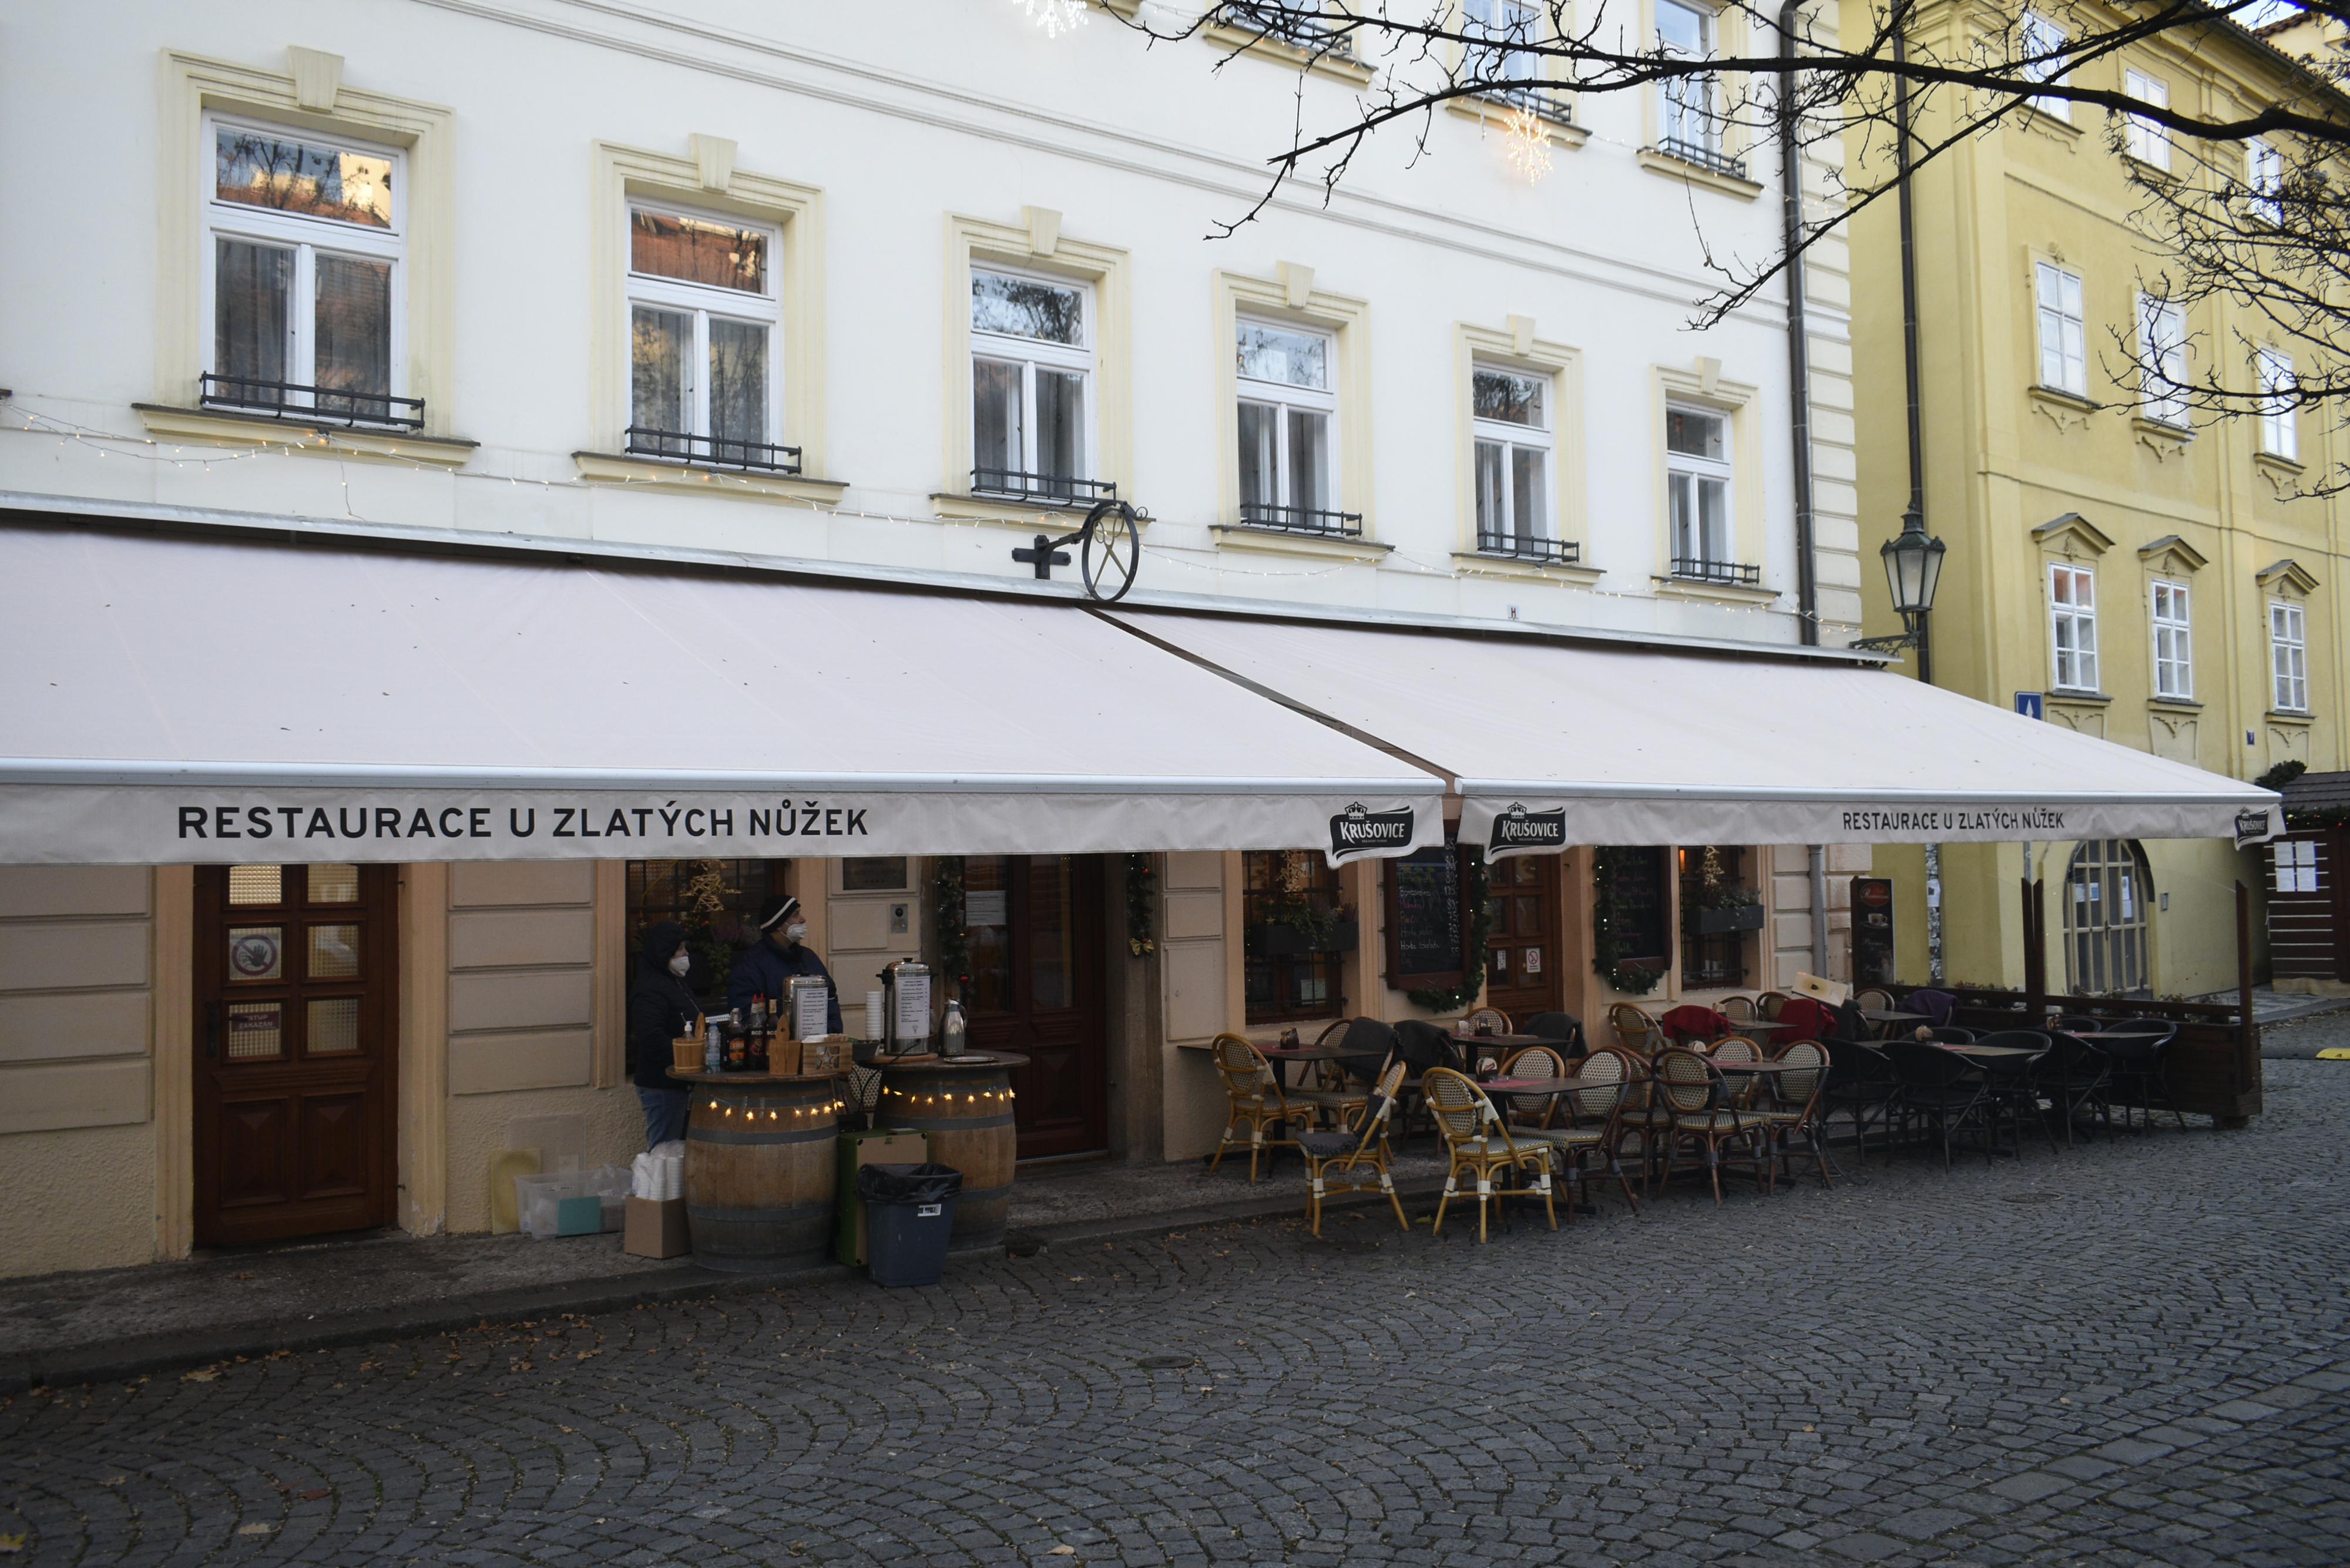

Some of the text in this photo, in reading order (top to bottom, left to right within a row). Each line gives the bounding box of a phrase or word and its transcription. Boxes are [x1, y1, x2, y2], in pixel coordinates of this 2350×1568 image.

[1511, 607, 1516, 617] H
[179, 799, 868, 838] RESTAURACE U ZLATÝCH NŮŽEK
[1843, 807, 2064, 830] RESTAURACE U ZLATÝCH NŮŽEK
[1340, 821, 1405, 844] KRUŠOVICE
[1501, 820, 1559, 841] KRUŠOVICE
